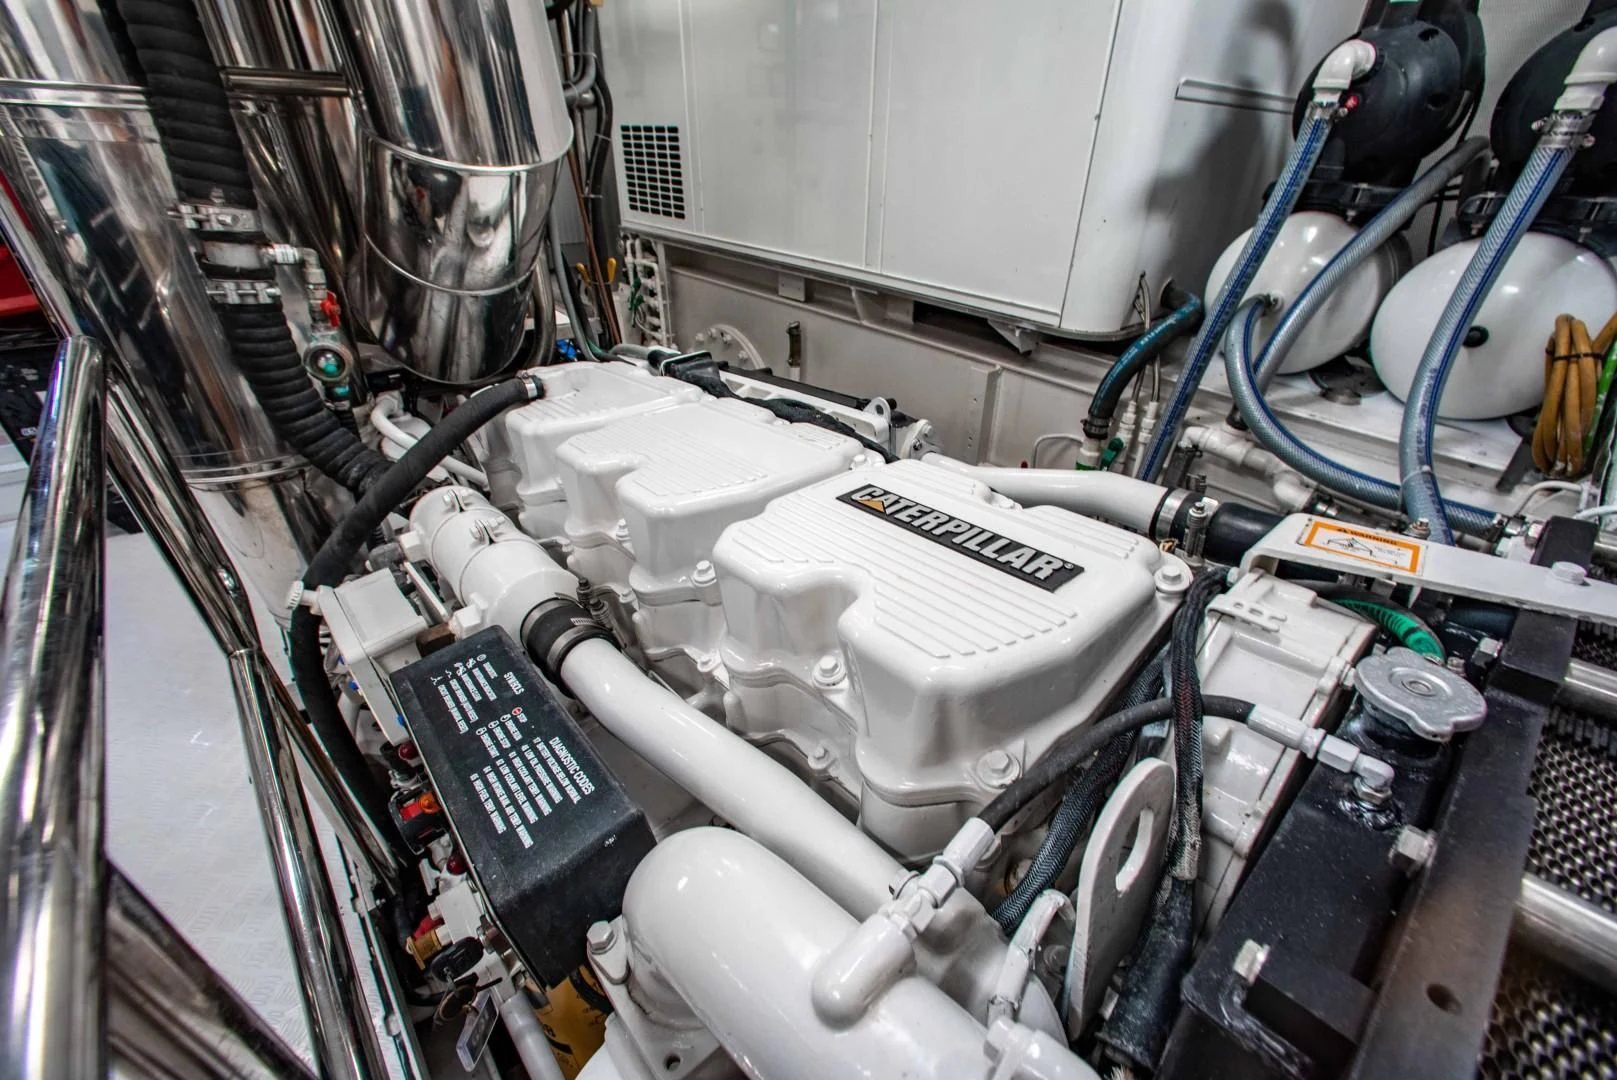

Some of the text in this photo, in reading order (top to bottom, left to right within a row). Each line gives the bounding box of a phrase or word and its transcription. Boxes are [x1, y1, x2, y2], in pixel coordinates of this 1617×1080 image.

[850, 486, 1065, 580] CATERPILLAR
[1350, 531, 1398, 545] WARNING
[504, 672, 524, 694] SYMBOLS
[524, 749, 535, 760] LOW
[499, 764, 510, 775] LOW
[518, 766, 534, 785] COOLANT
[549, 737, 595, 795] DIAGNOSTIC CODES
[504, 773, 520, 792] COOLANT
